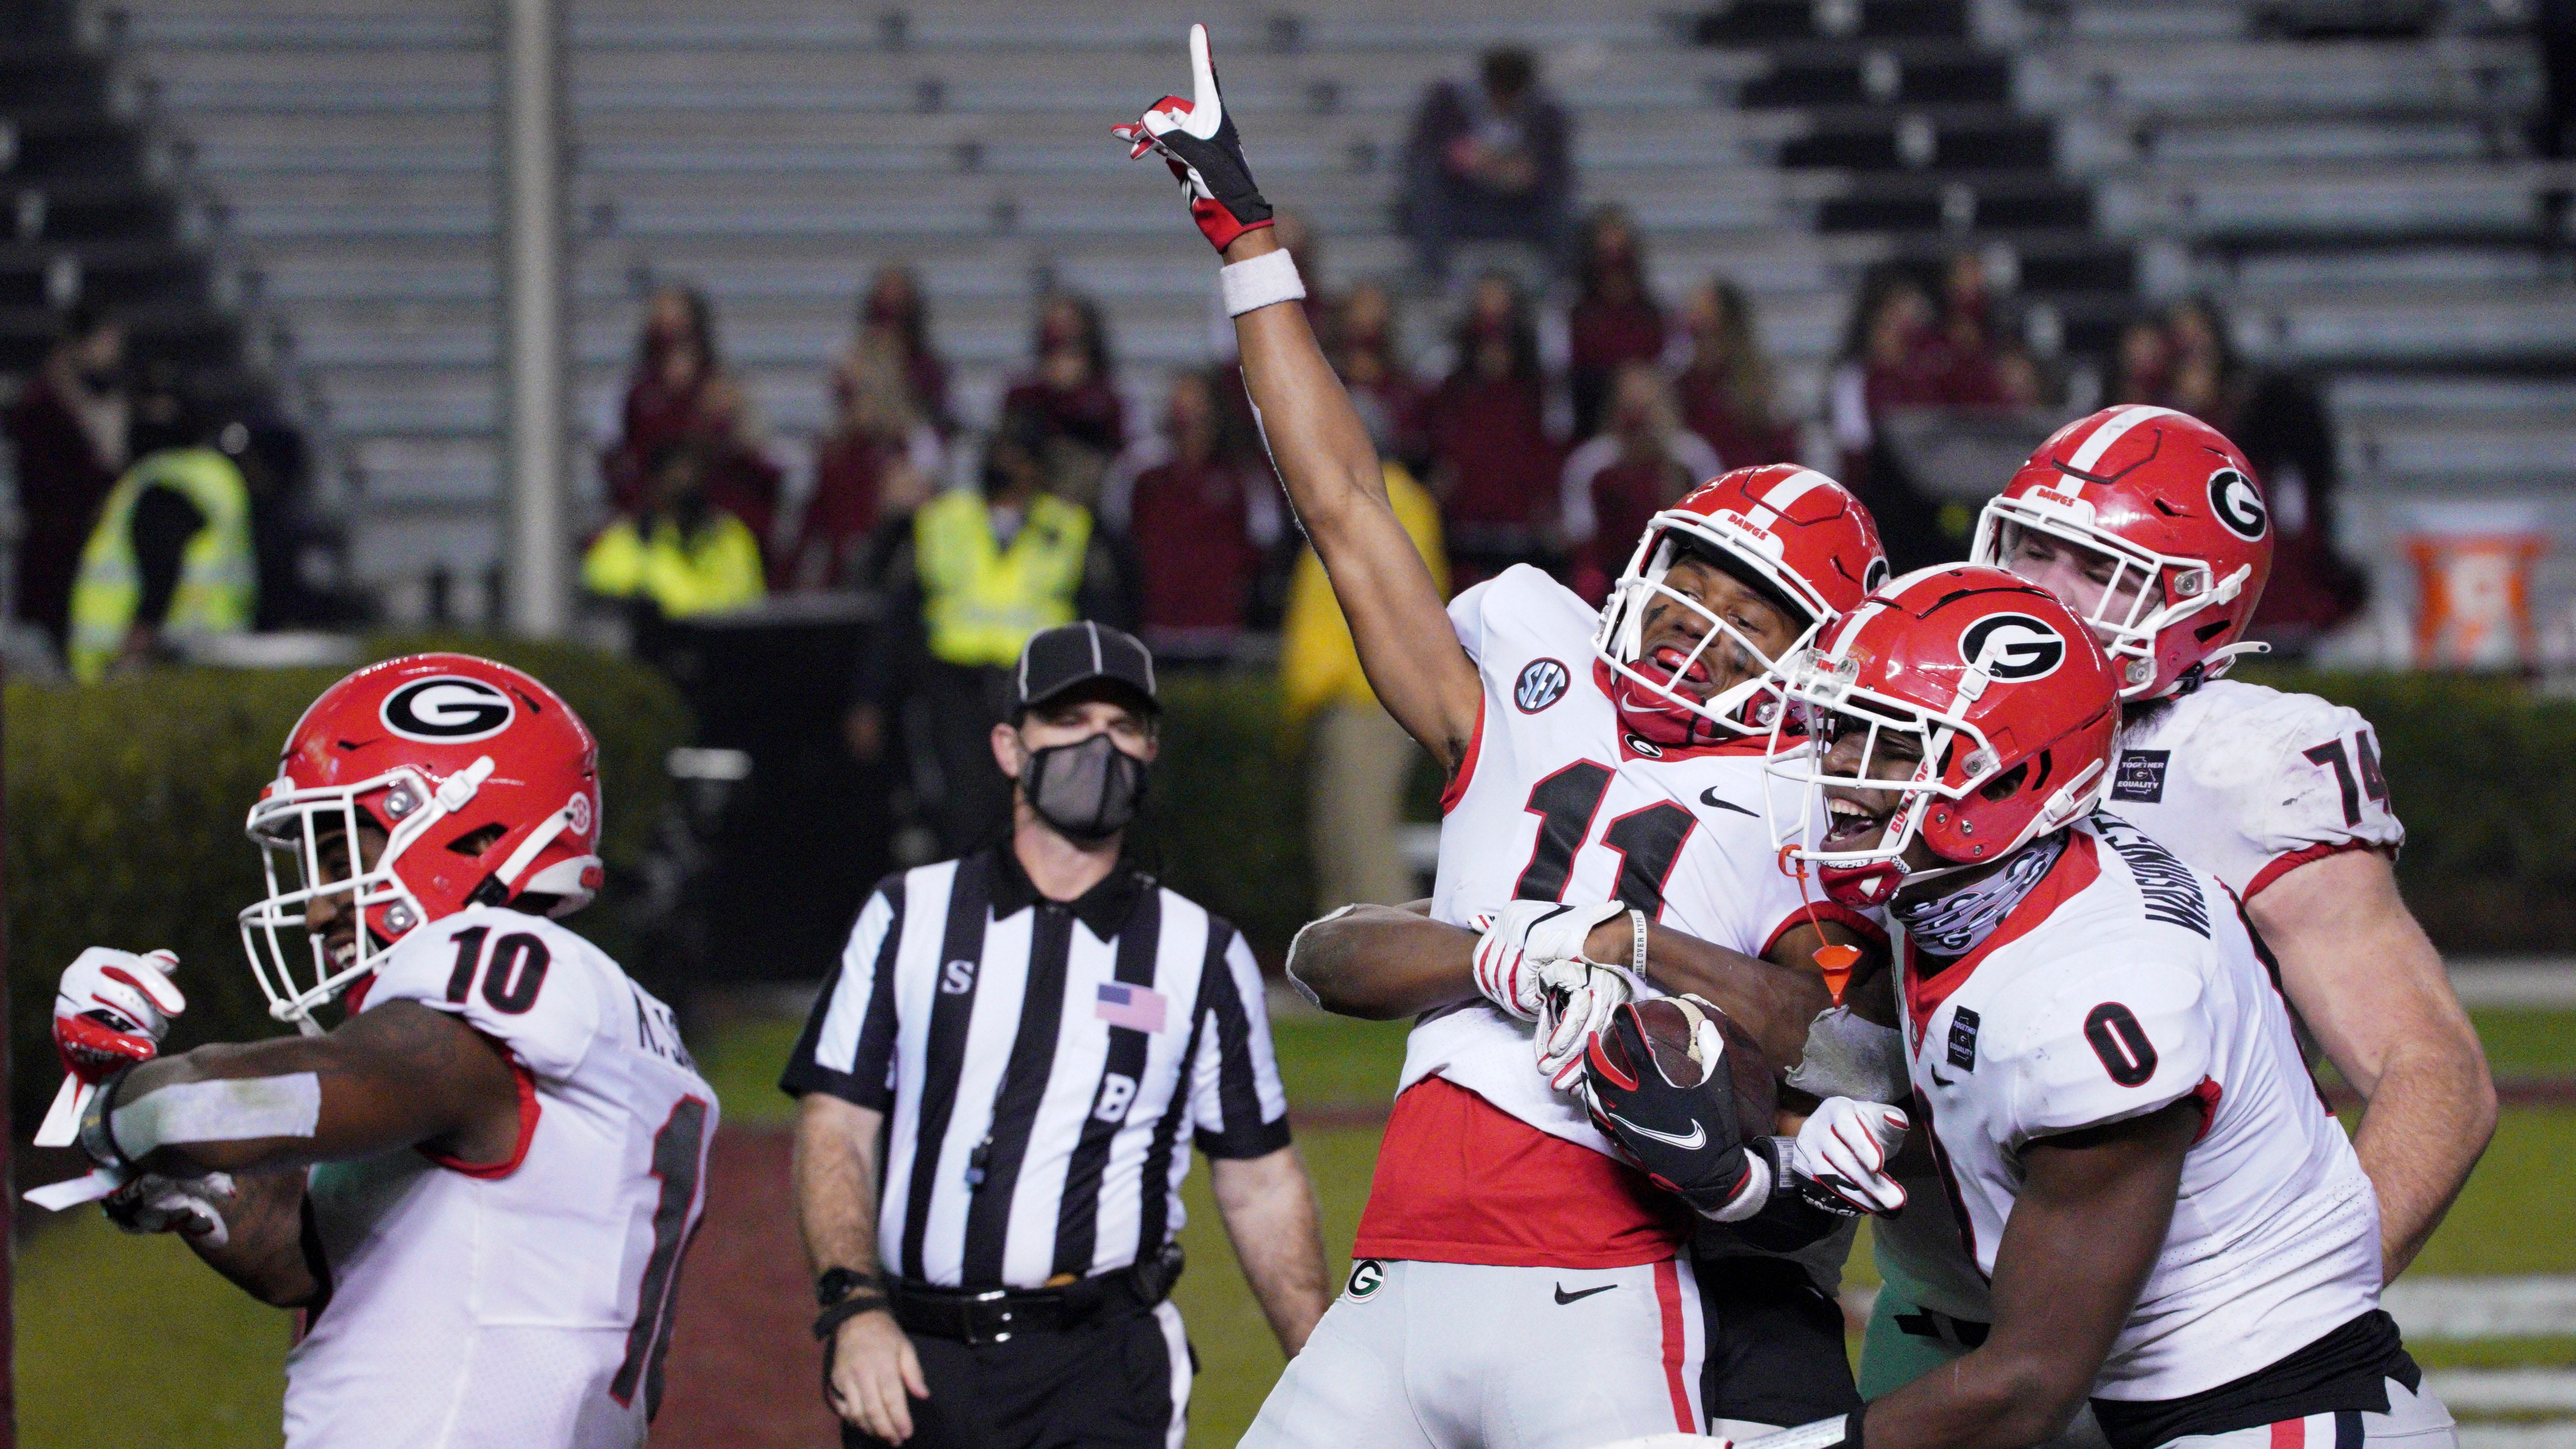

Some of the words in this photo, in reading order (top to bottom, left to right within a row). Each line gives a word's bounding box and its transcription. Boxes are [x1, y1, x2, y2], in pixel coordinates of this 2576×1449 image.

[2037, 487, 2076, 507] DAWGS
[1727, 513, 1769, 540] DAWGS
[387, 680, 509, 736] G
[1518, 661, 1566, 709] SEC
[2117, 781, 2159, 789] EQUALITY
[1511, 758, 1699, 923] 11
[446, 926, 551, 1014] 10
[943, 960, 975, 994] S
[2084, 1002, 2158, 1088] 0
[1094, 1073, 1137, 1123] B
[1348, 1260, 1383, 1296] G
